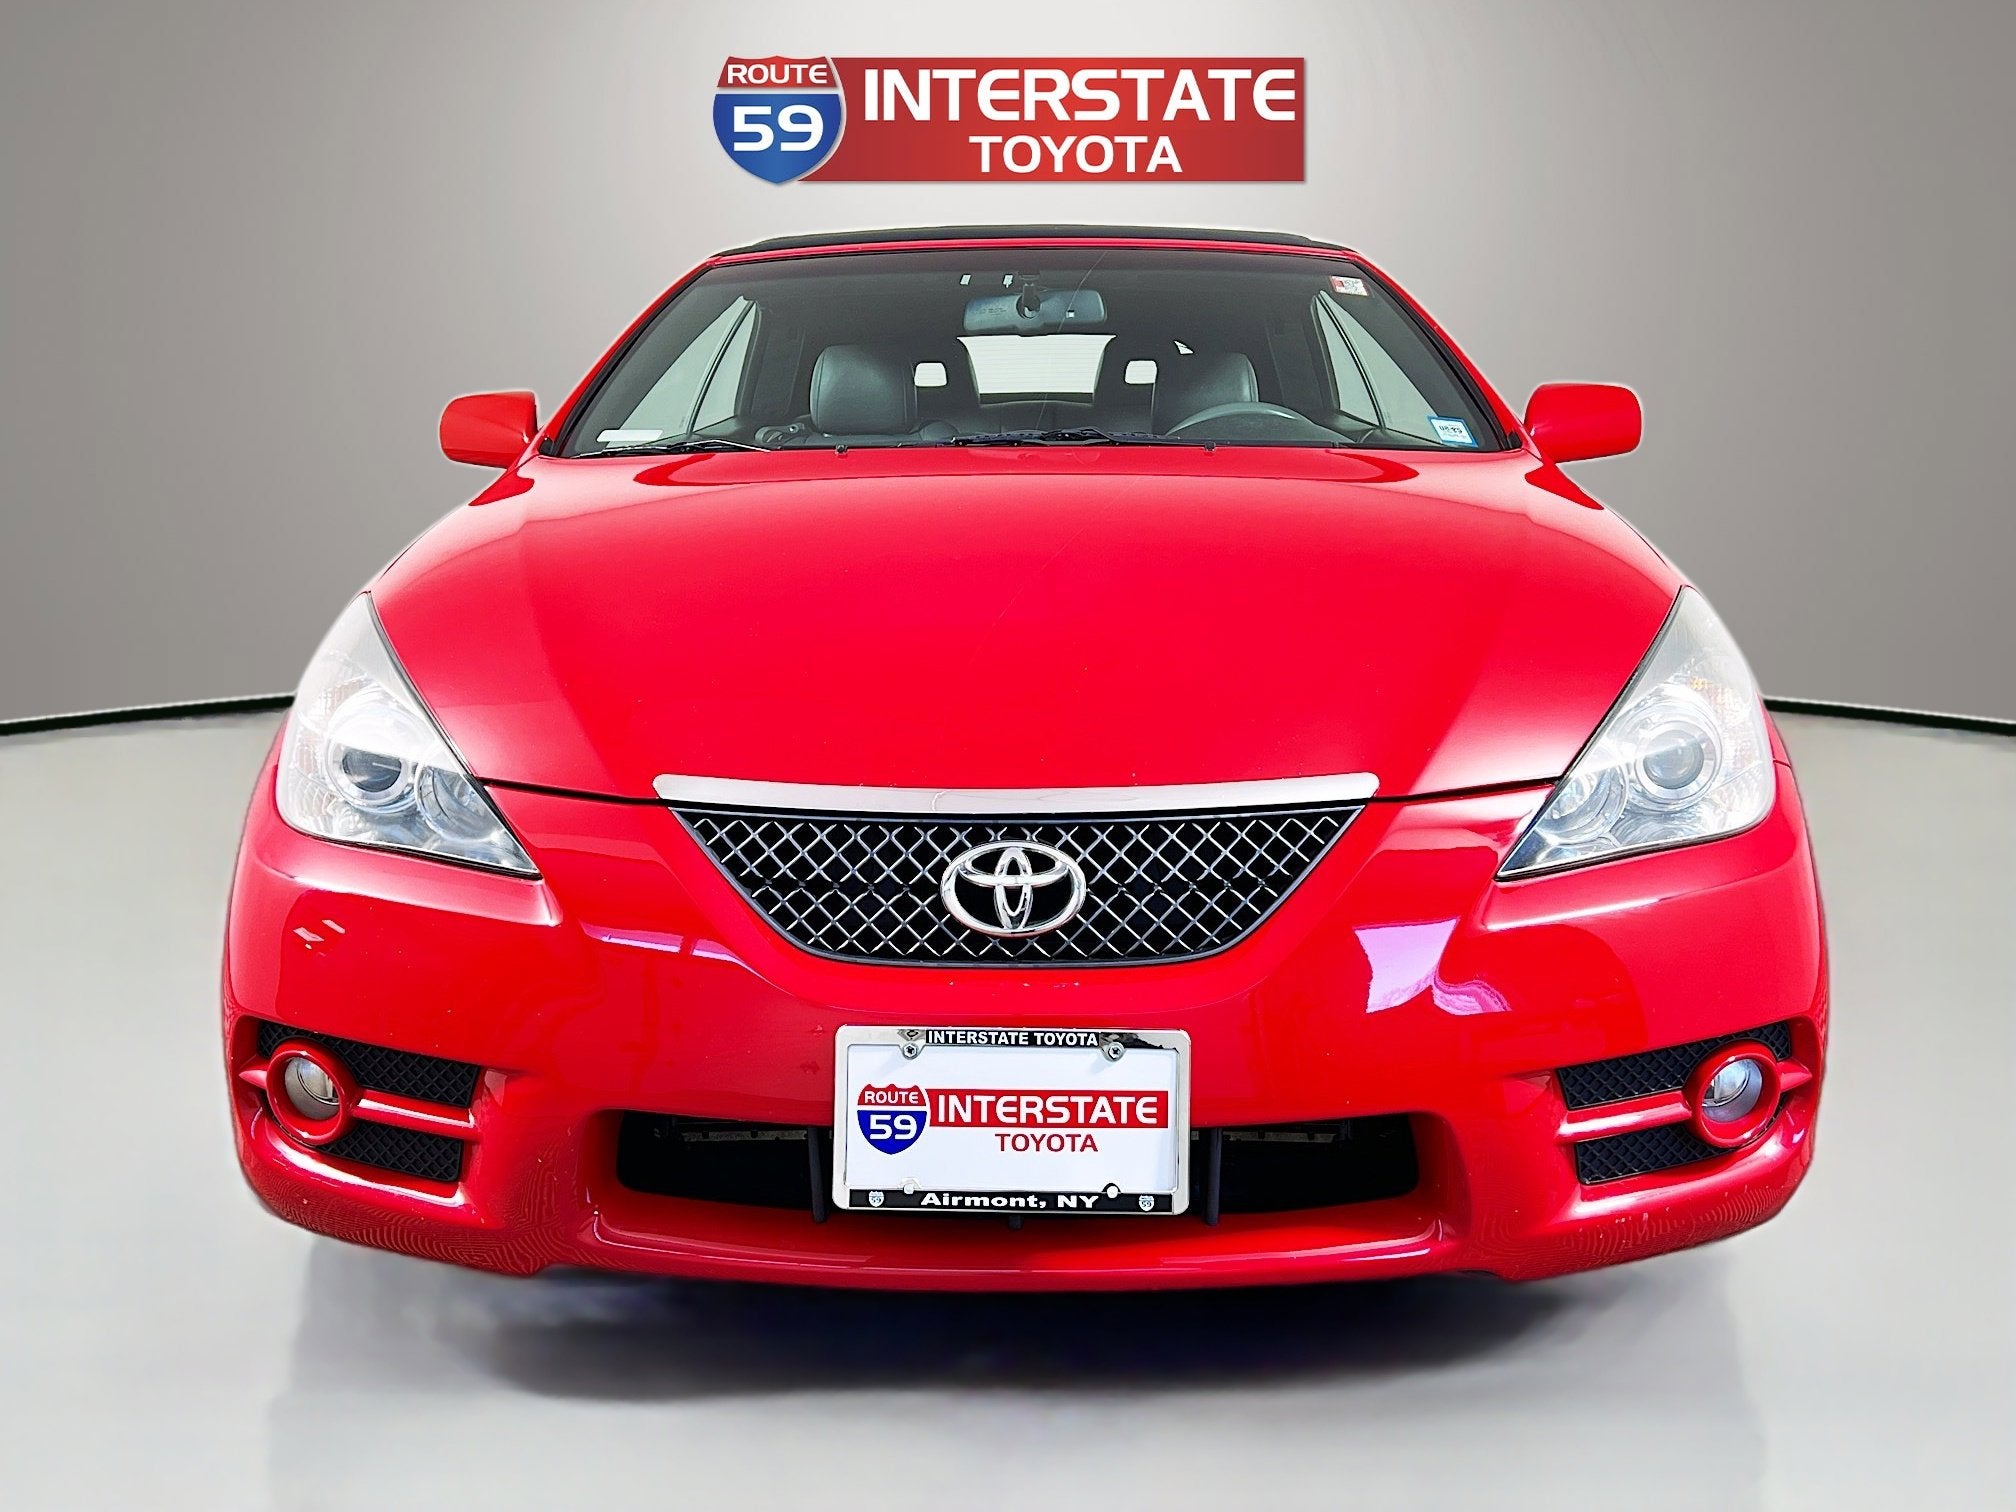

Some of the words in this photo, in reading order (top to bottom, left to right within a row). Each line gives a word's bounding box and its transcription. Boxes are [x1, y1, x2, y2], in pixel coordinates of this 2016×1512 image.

[928, 1030, 1029, 1046] INTERSTATE
[1034, 1031, 1099, 1047] TOYOTA
[864, 1090, 919, 1105] ROUTE
[938, 1094, 1158, 1125] INTERSTATE
[869, 1114, 918, 1140] 59
[994, 1133, 1099, 1153] TOYOTA
[920, 1192, 1047, 1209] Airmont,
[1057, 1195, 1100, 1209] NY
